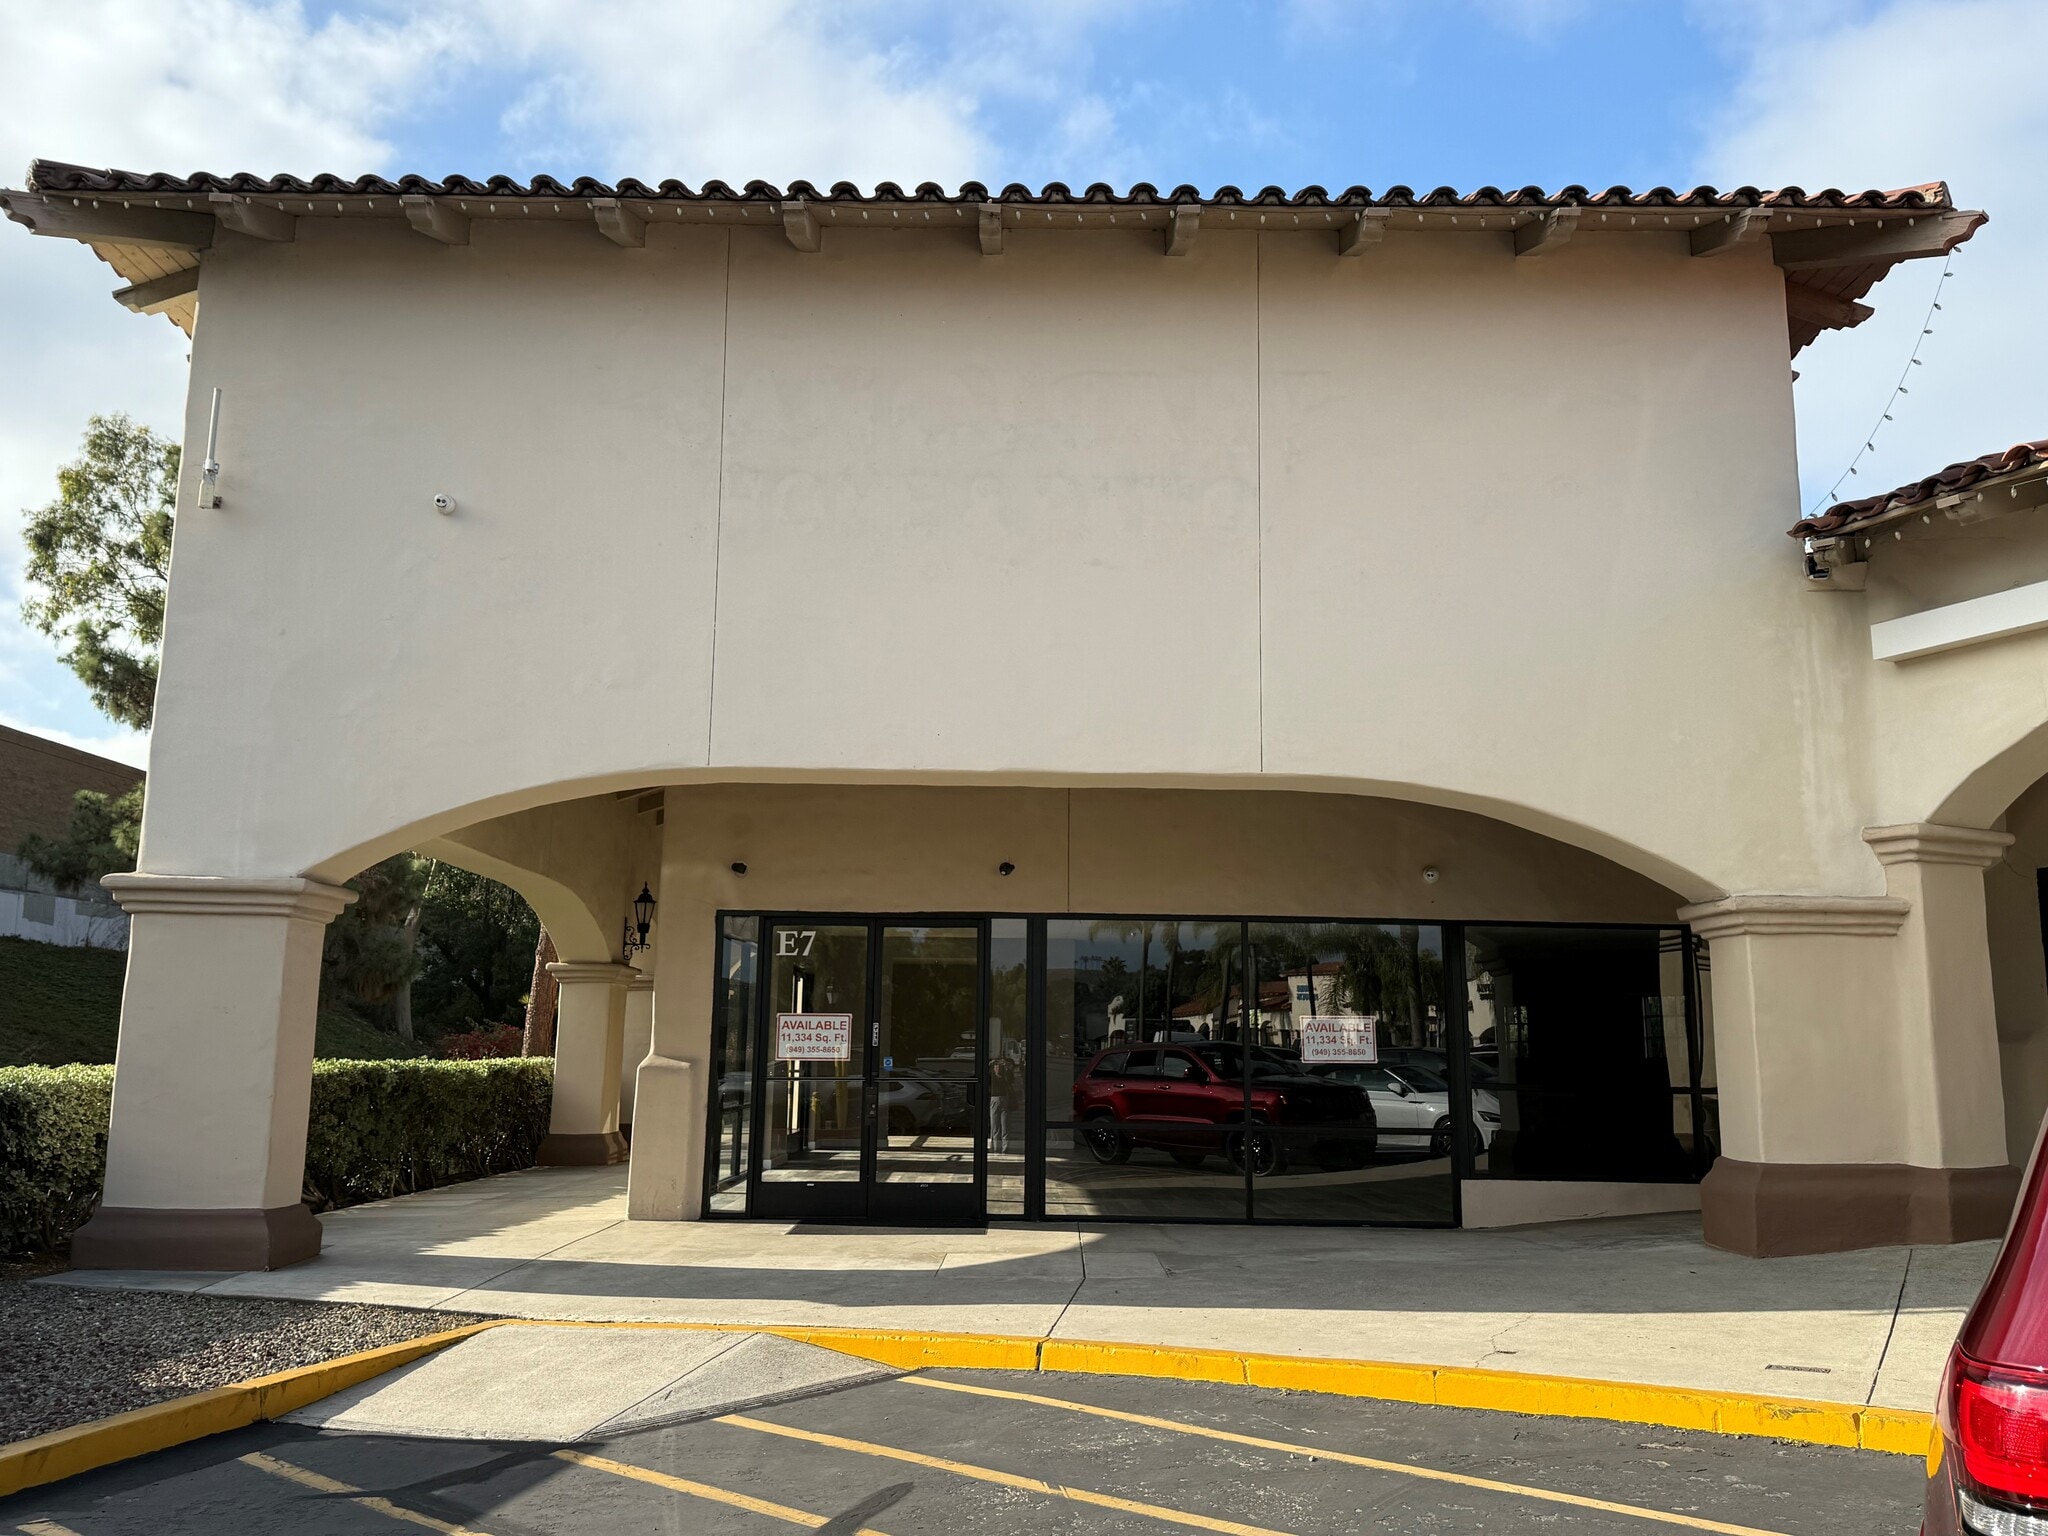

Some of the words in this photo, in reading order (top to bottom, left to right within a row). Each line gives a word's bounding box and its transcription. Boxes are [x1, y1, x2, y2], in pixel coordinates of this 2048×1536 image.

[776, 930, 817, 957] E7
[781, 1020, 848, 1031] AVAILABLE
[1305, 1022, 1371, 1033] AVAILABLE
[781, 1033, 812, 1043] 11,334
[815, 1033, 832, 1044] Sq.
[834, 1033, 847, 1043] Ft.
[1305, 1035, 1337, 1045] 11,334
[1359, 1035, 1373, 1045] Ft.
[786, 1045, 805, 1054] (949)
[1311, 1048, 1331, 1057] (949)
